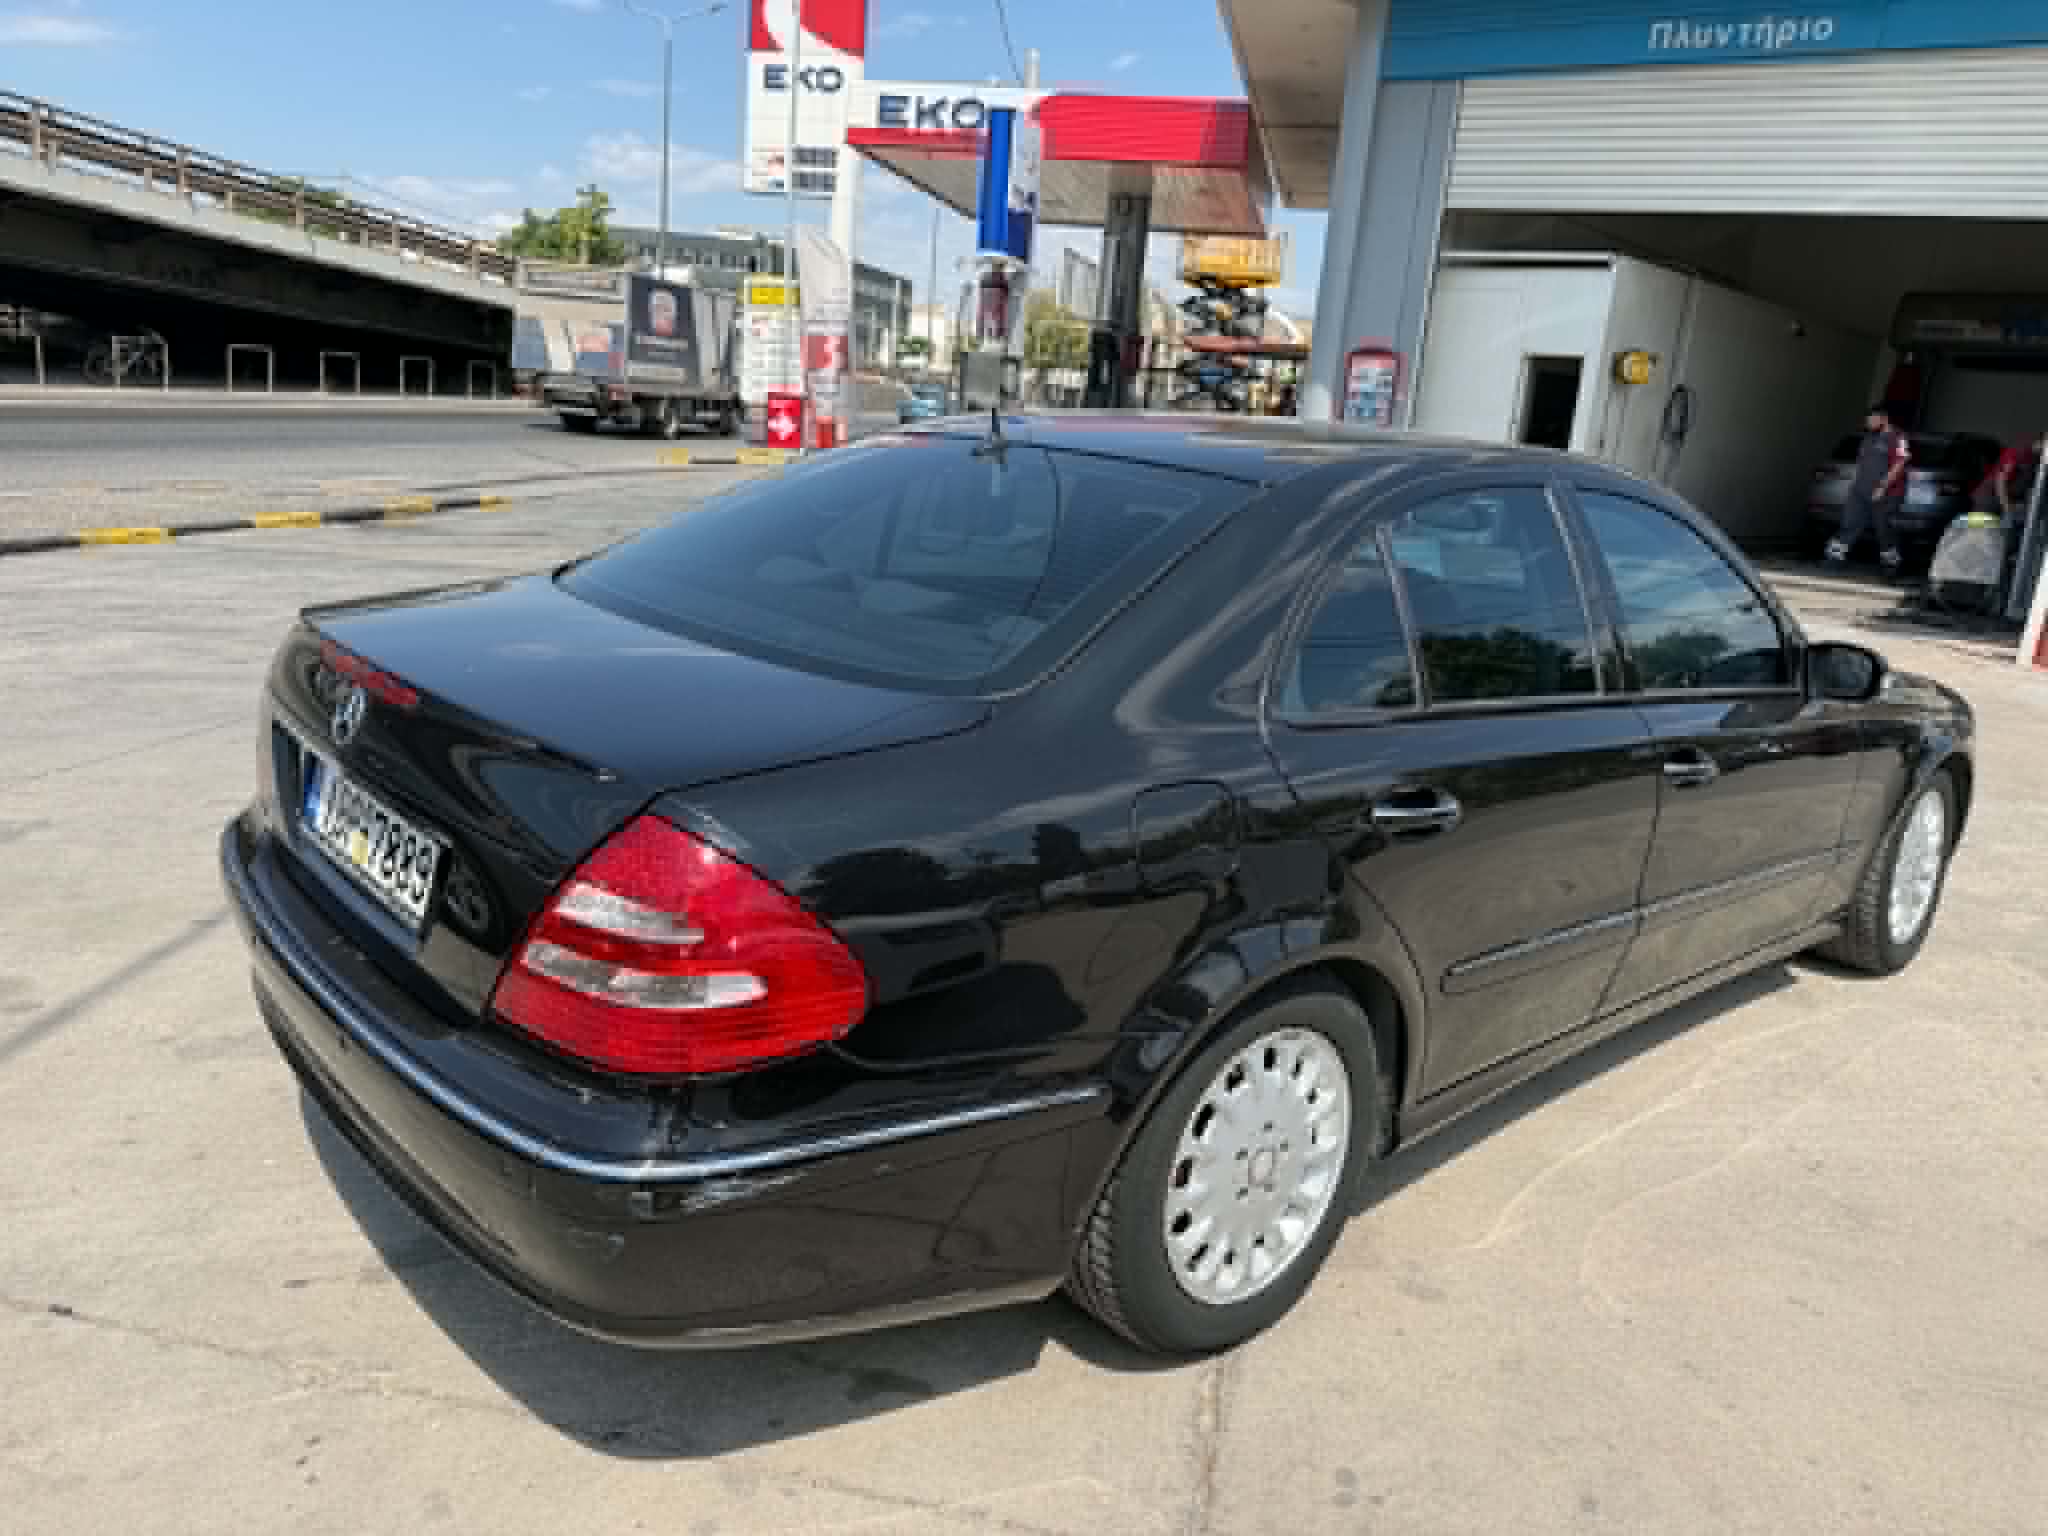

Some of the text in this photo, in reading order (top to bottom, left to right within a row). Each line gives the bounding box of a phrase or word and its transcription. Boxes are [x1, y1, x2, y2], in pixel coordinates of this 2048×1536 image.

[1648, 15, 1837, 52] Πλυντήριο
[762, 64, 845, 93] EKO
[878, 95, 986, 129] EKO
